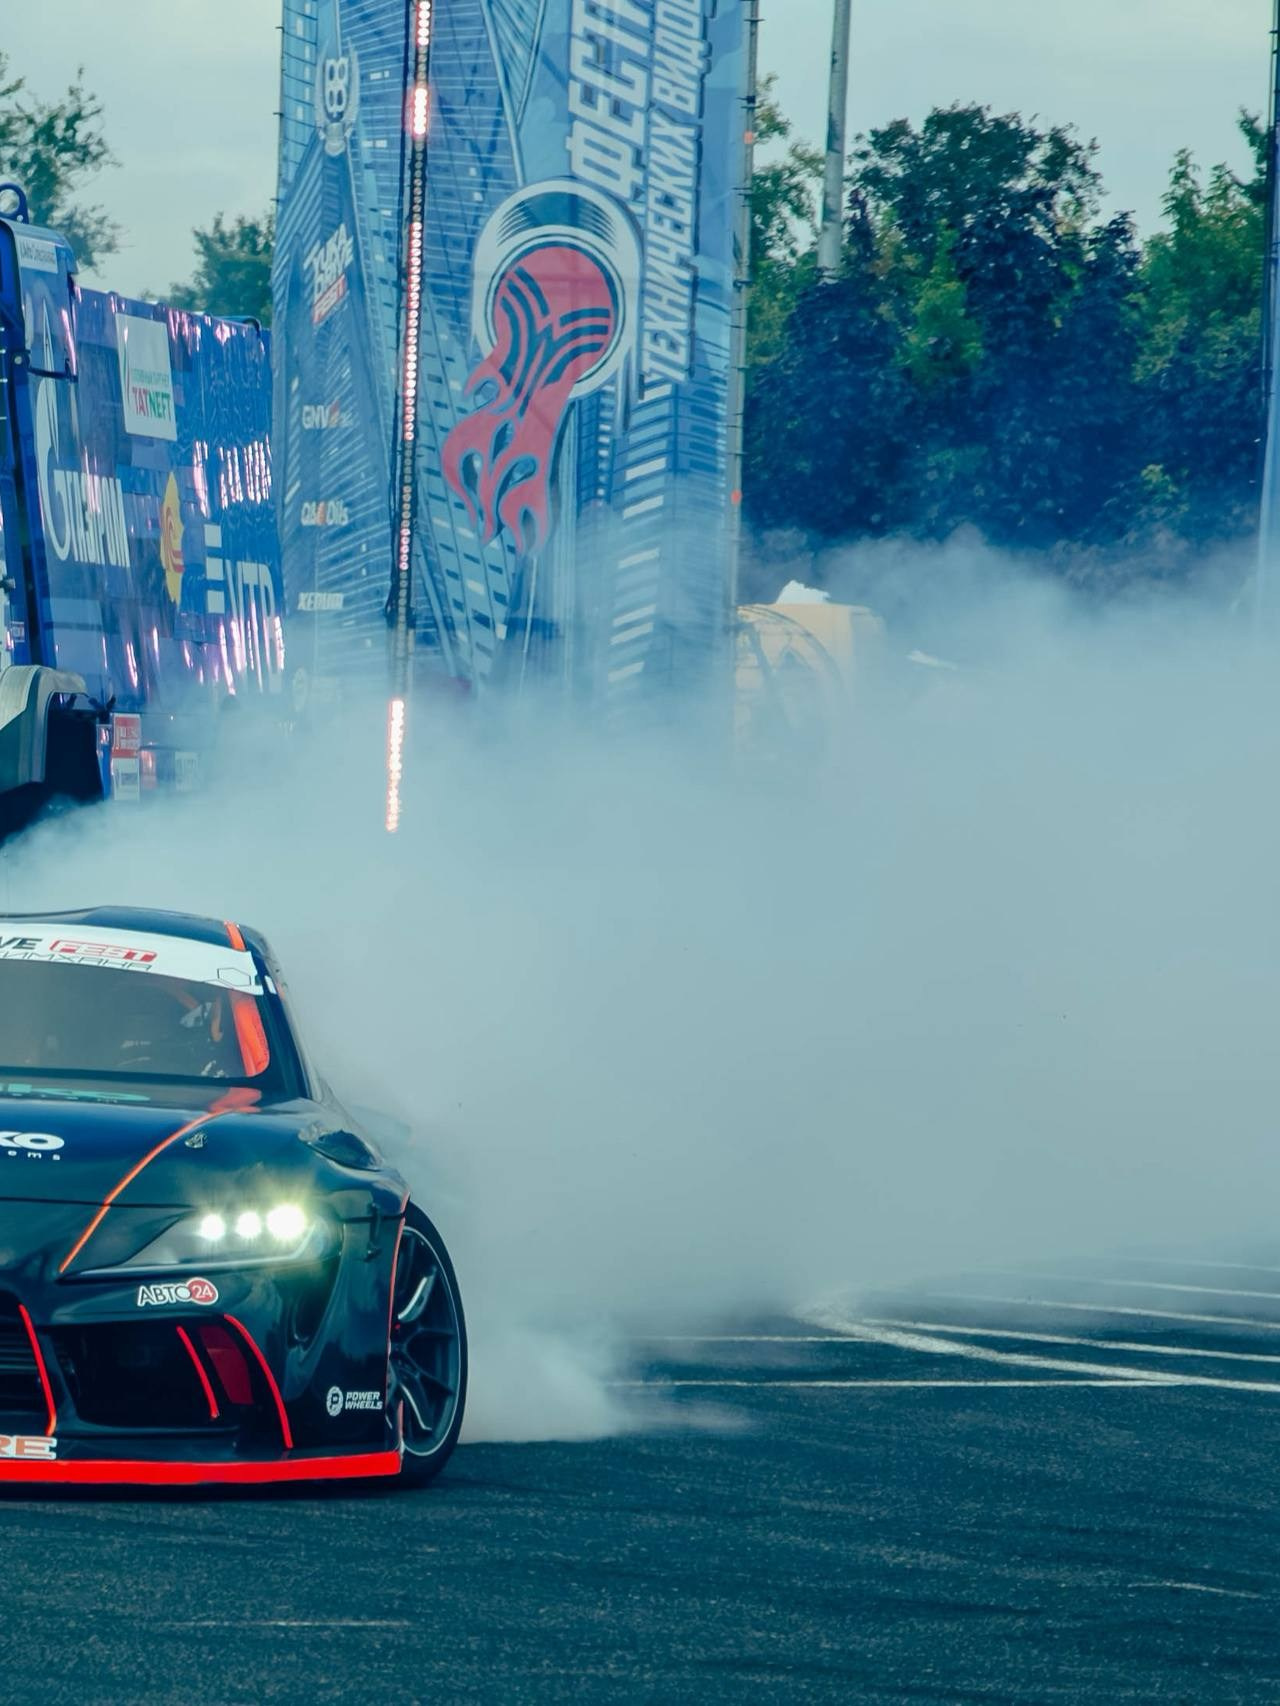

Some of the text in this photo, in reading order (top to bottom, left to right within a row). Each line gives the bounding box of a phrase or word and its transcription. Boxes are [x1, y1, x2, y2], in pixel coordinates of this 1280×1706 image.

[566, 0, 652, 200] ФЕСТ
[641, 108, 696, 382] ТЕХНИЧЕСКИХ
[132, 386, 172, 421] TATNEFT
[53, 942, 156, 962] FEST
[344, 1401, 384, 1411] WHEELS
[345, 1391, 381, 1401] POWER
